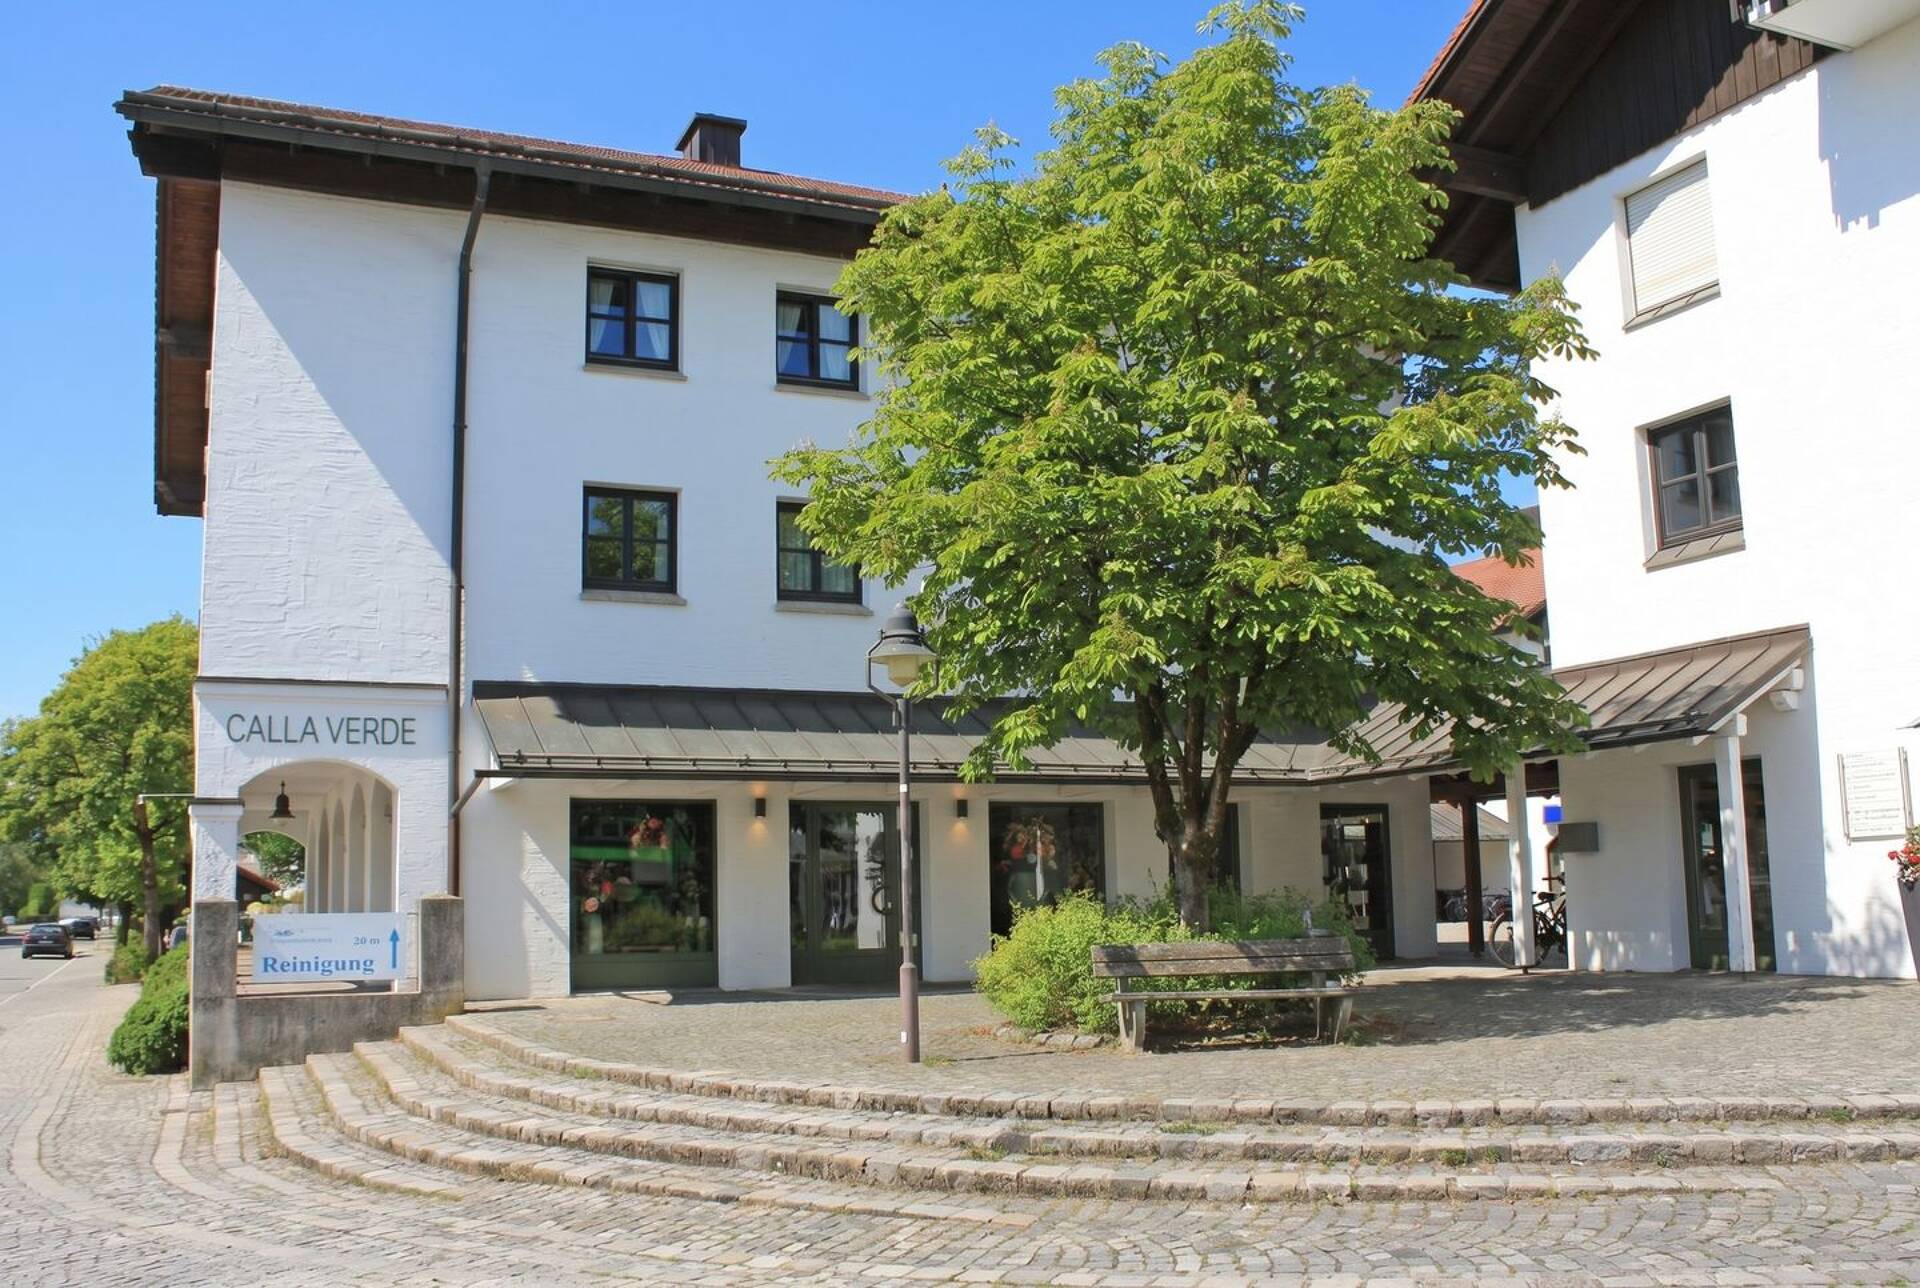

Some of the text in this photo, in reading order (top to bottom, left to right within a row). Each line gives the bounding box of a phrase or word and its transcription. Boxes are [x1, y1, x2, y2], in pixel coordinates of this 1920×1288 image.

[227, 713, 416, 745] CALLA VERDE
[353, 936, 366, 945] 20
[262, 956, 375, 975] Reinigung
